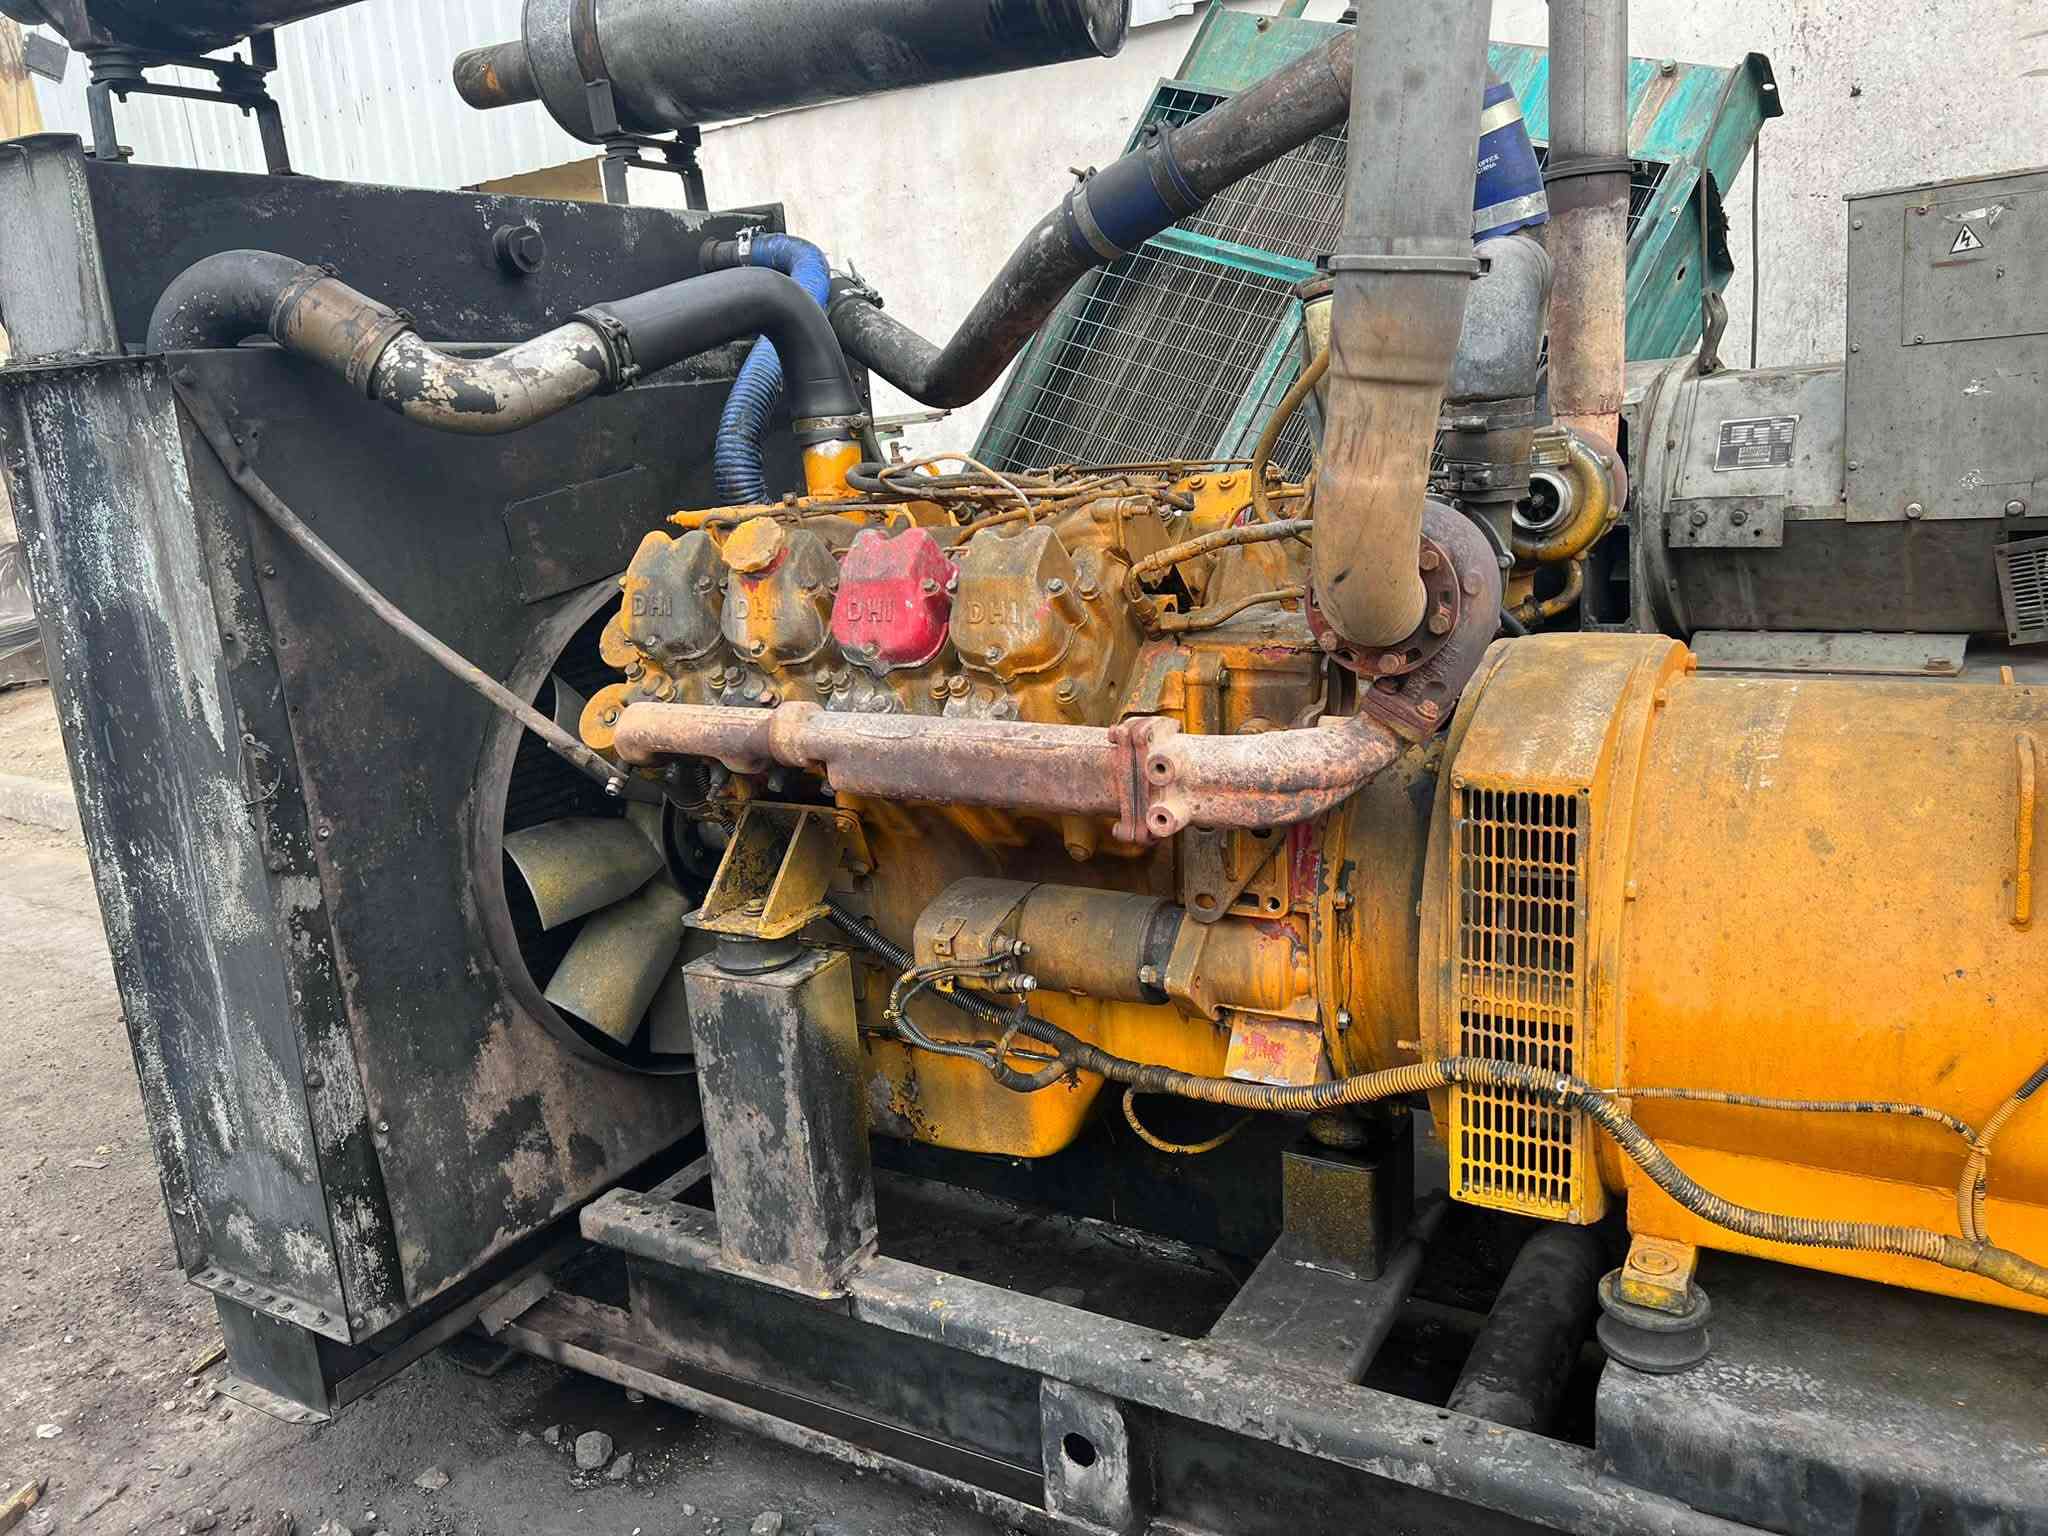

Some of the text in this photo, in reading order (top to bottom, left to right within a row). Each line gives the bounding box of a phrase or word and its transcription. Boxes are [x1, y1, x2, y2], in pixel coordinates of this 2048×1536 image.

[632, 591, 672, 617] DHI
[848, 597, 894, 623] DHI
[967, 599, 1018, 625] DHI
